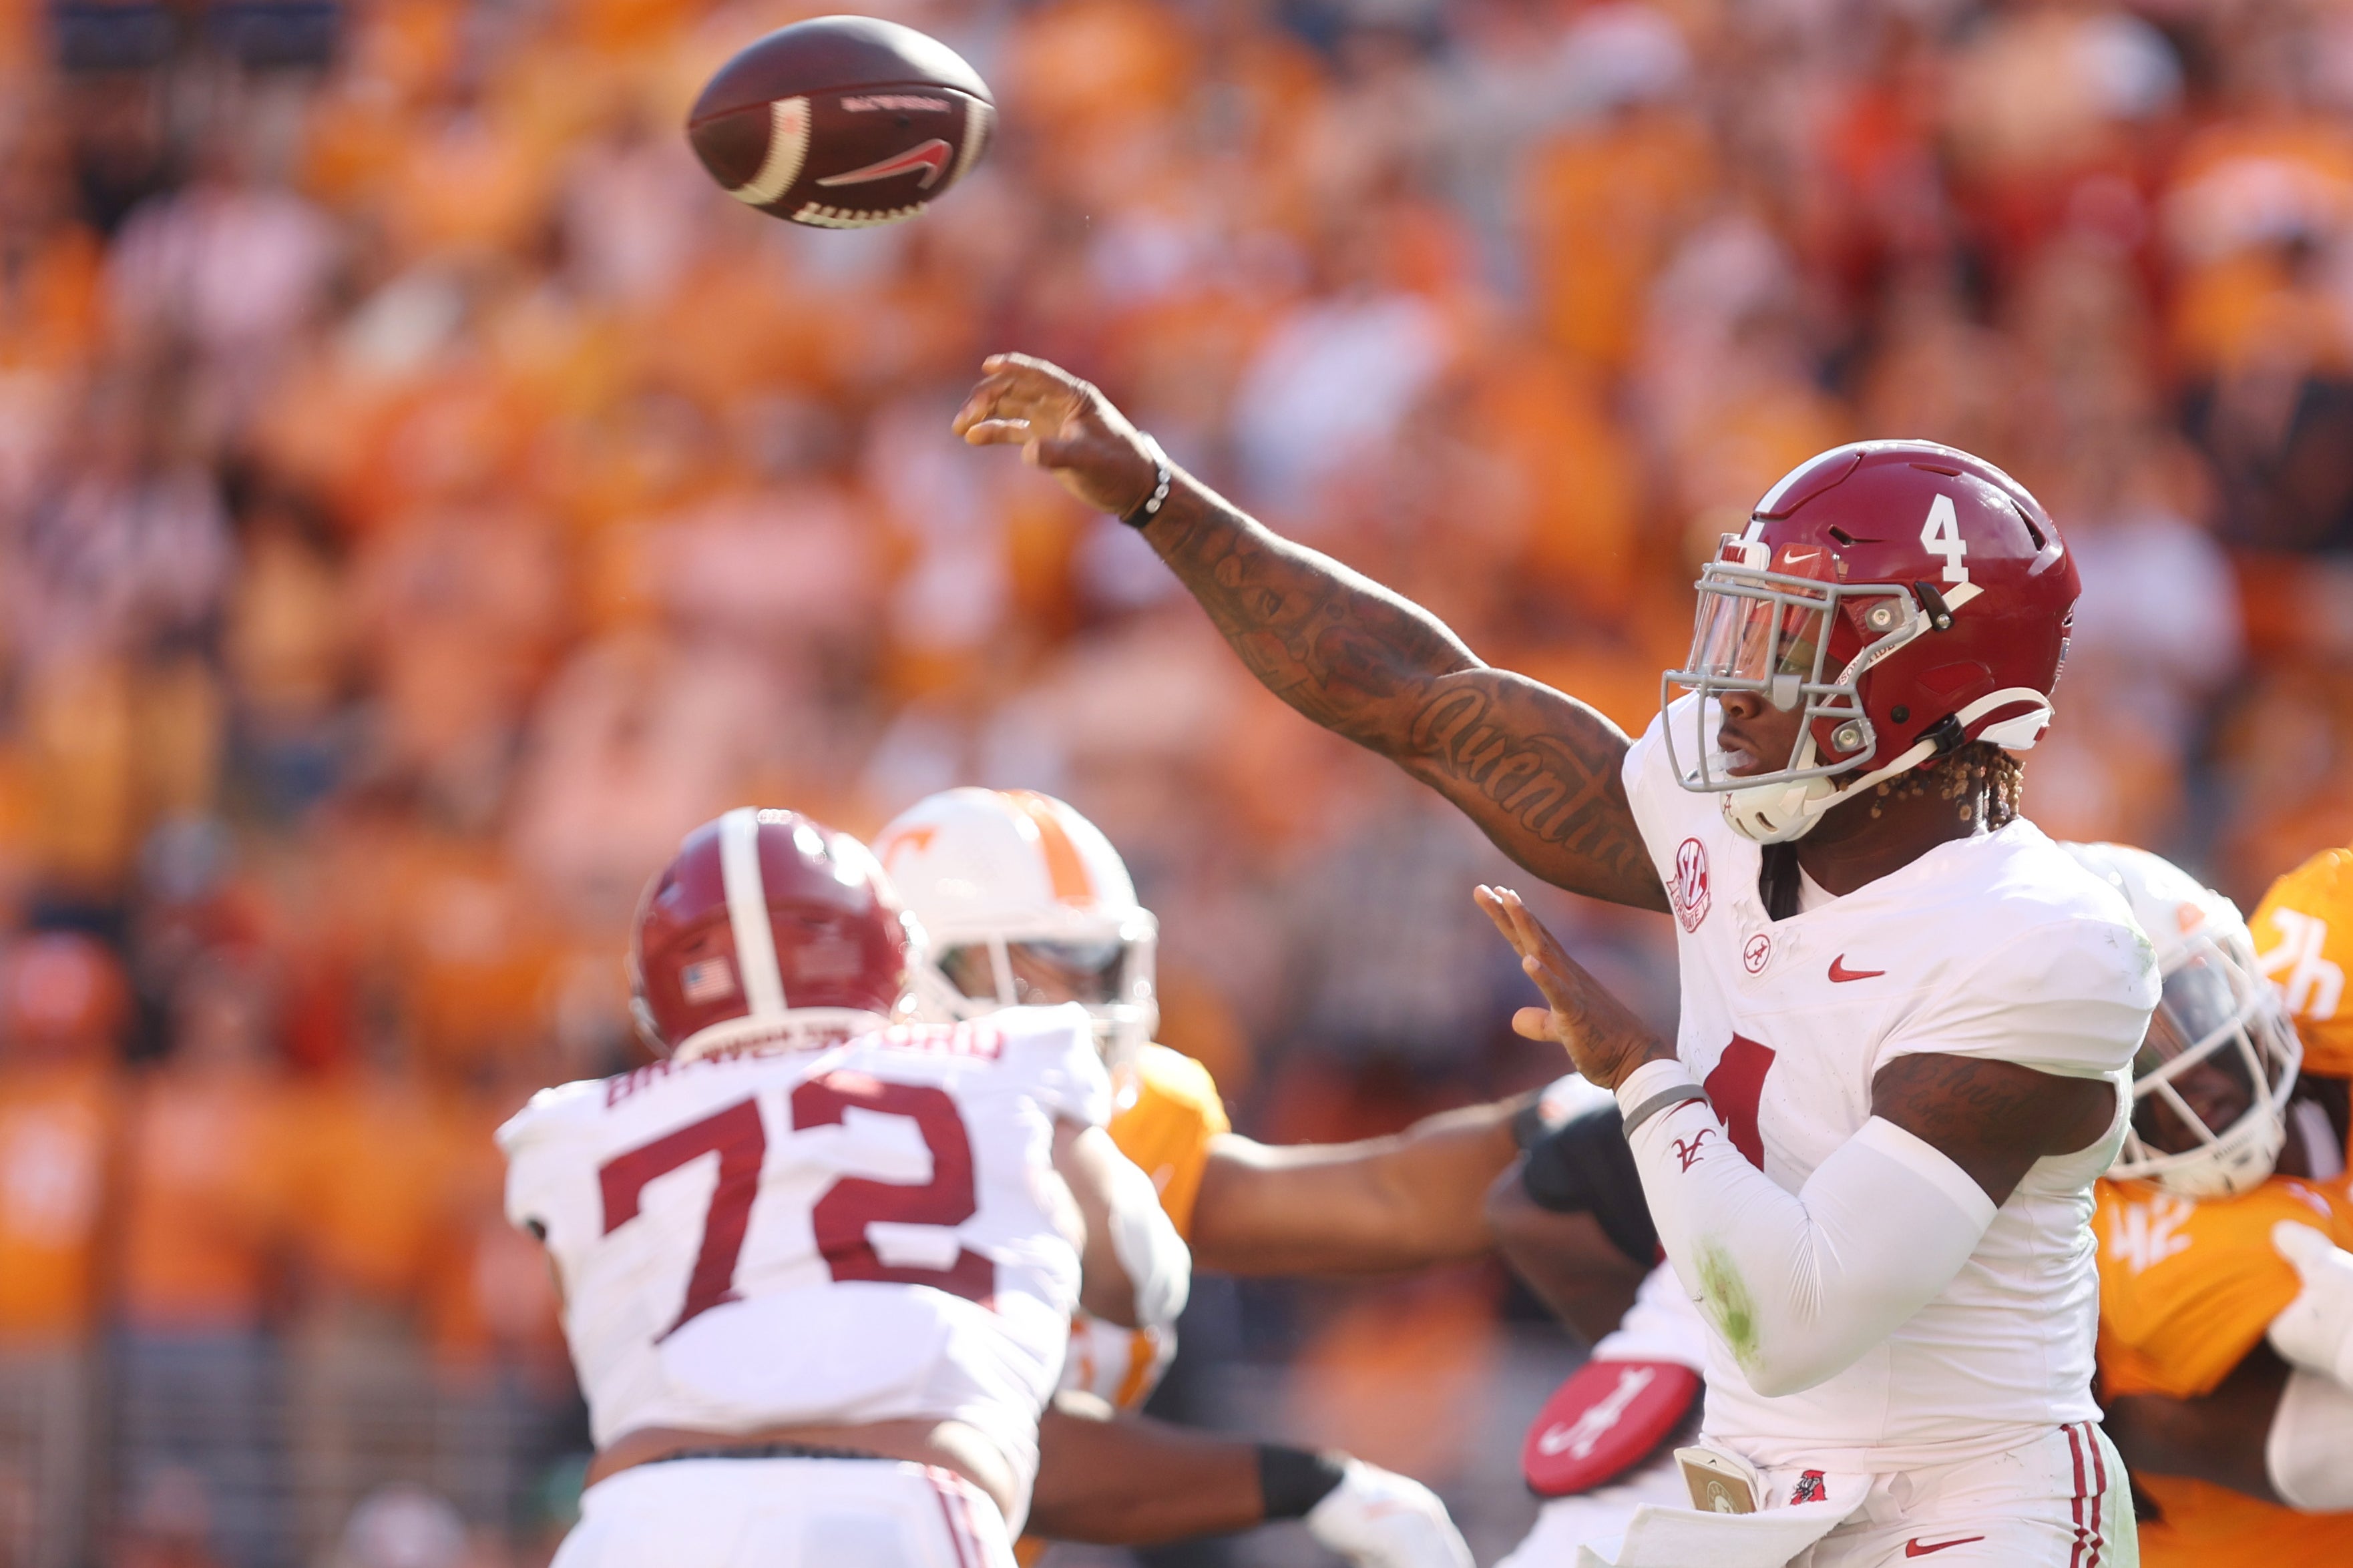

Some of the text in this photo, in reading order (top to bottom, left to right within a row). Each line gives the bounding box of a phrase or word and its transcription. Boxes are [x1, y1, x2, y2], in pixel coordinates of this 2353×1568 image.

[1920, 493, 1969, 582] 4
[598, 1071, 996, 1344] 72
[2107, 1192, 2198, 1275] 42
